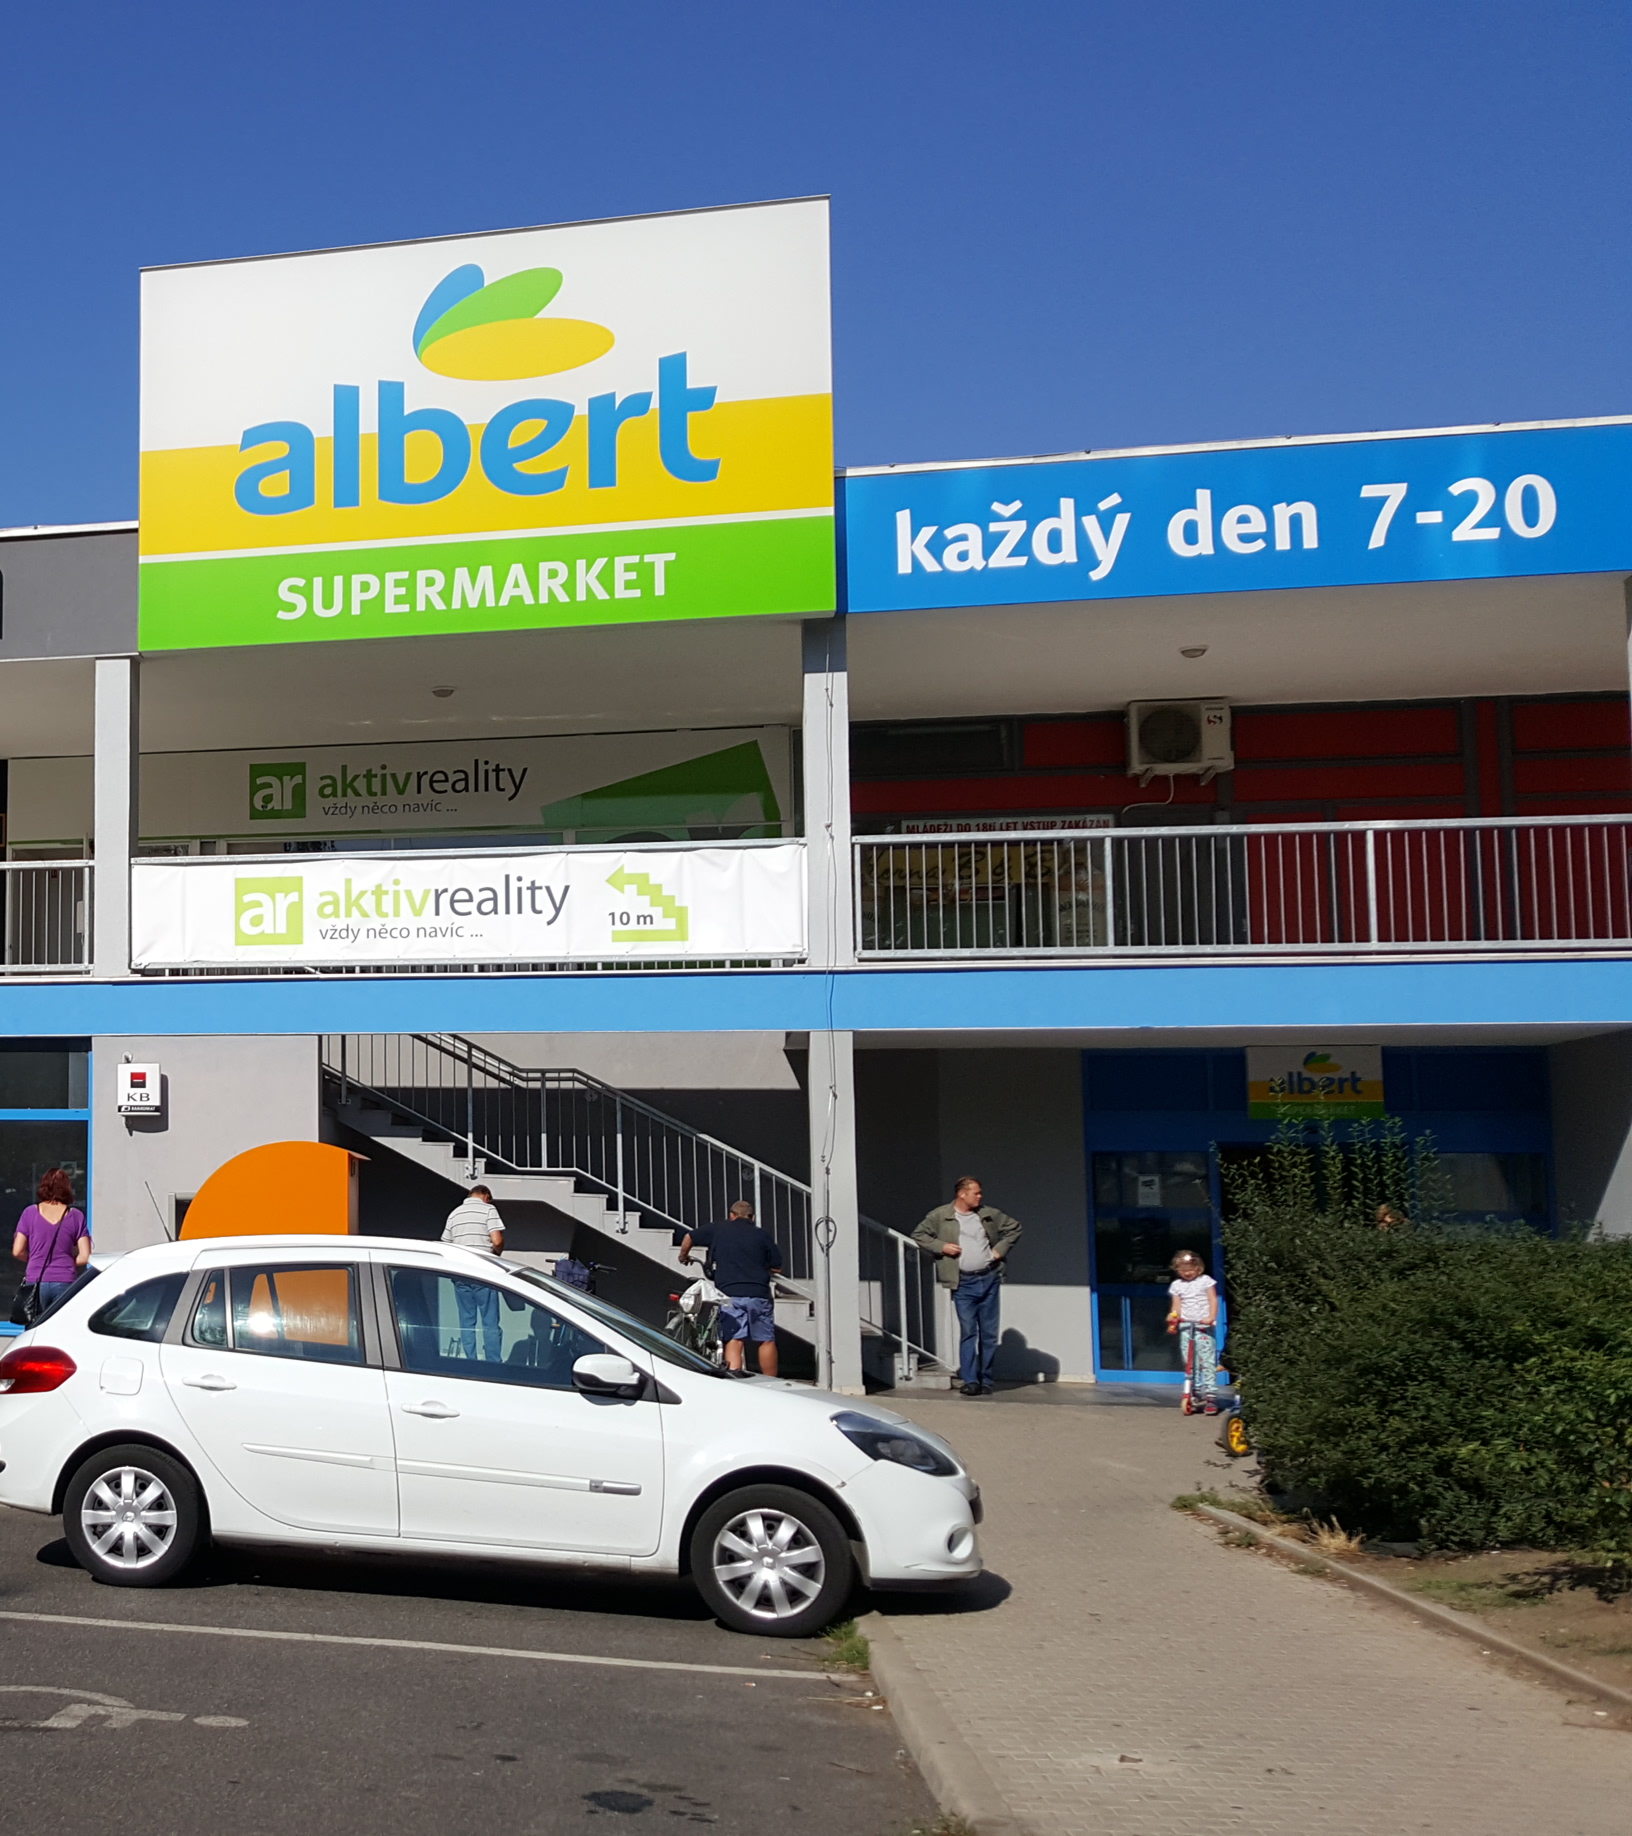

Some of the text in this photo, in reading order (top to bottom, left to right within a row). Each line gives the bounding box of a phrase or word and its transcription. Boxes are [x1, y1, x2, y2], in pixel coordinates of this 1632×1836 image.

[234, 351, 721, 515] albert
[896, 474, 1557, 581] každý den 7-20
[277, 552, 675, 620] SUPERMARKET
[253, 759, 528, 811] ar aktivreality
[322, 802, 357, 818] vždy
[361, 801, 398, 815] něco
[403, 799, 442, 813] navíc
[239, 874, 570, 934] ar aktivreality
[608, 911, 654, 926] 10 m
[319, 925, 360, 943] vždy
[366, 924, 411, 939] něco
[417, 922, 464, 938] navíc
[127, 1092, 151, 1102] KB
